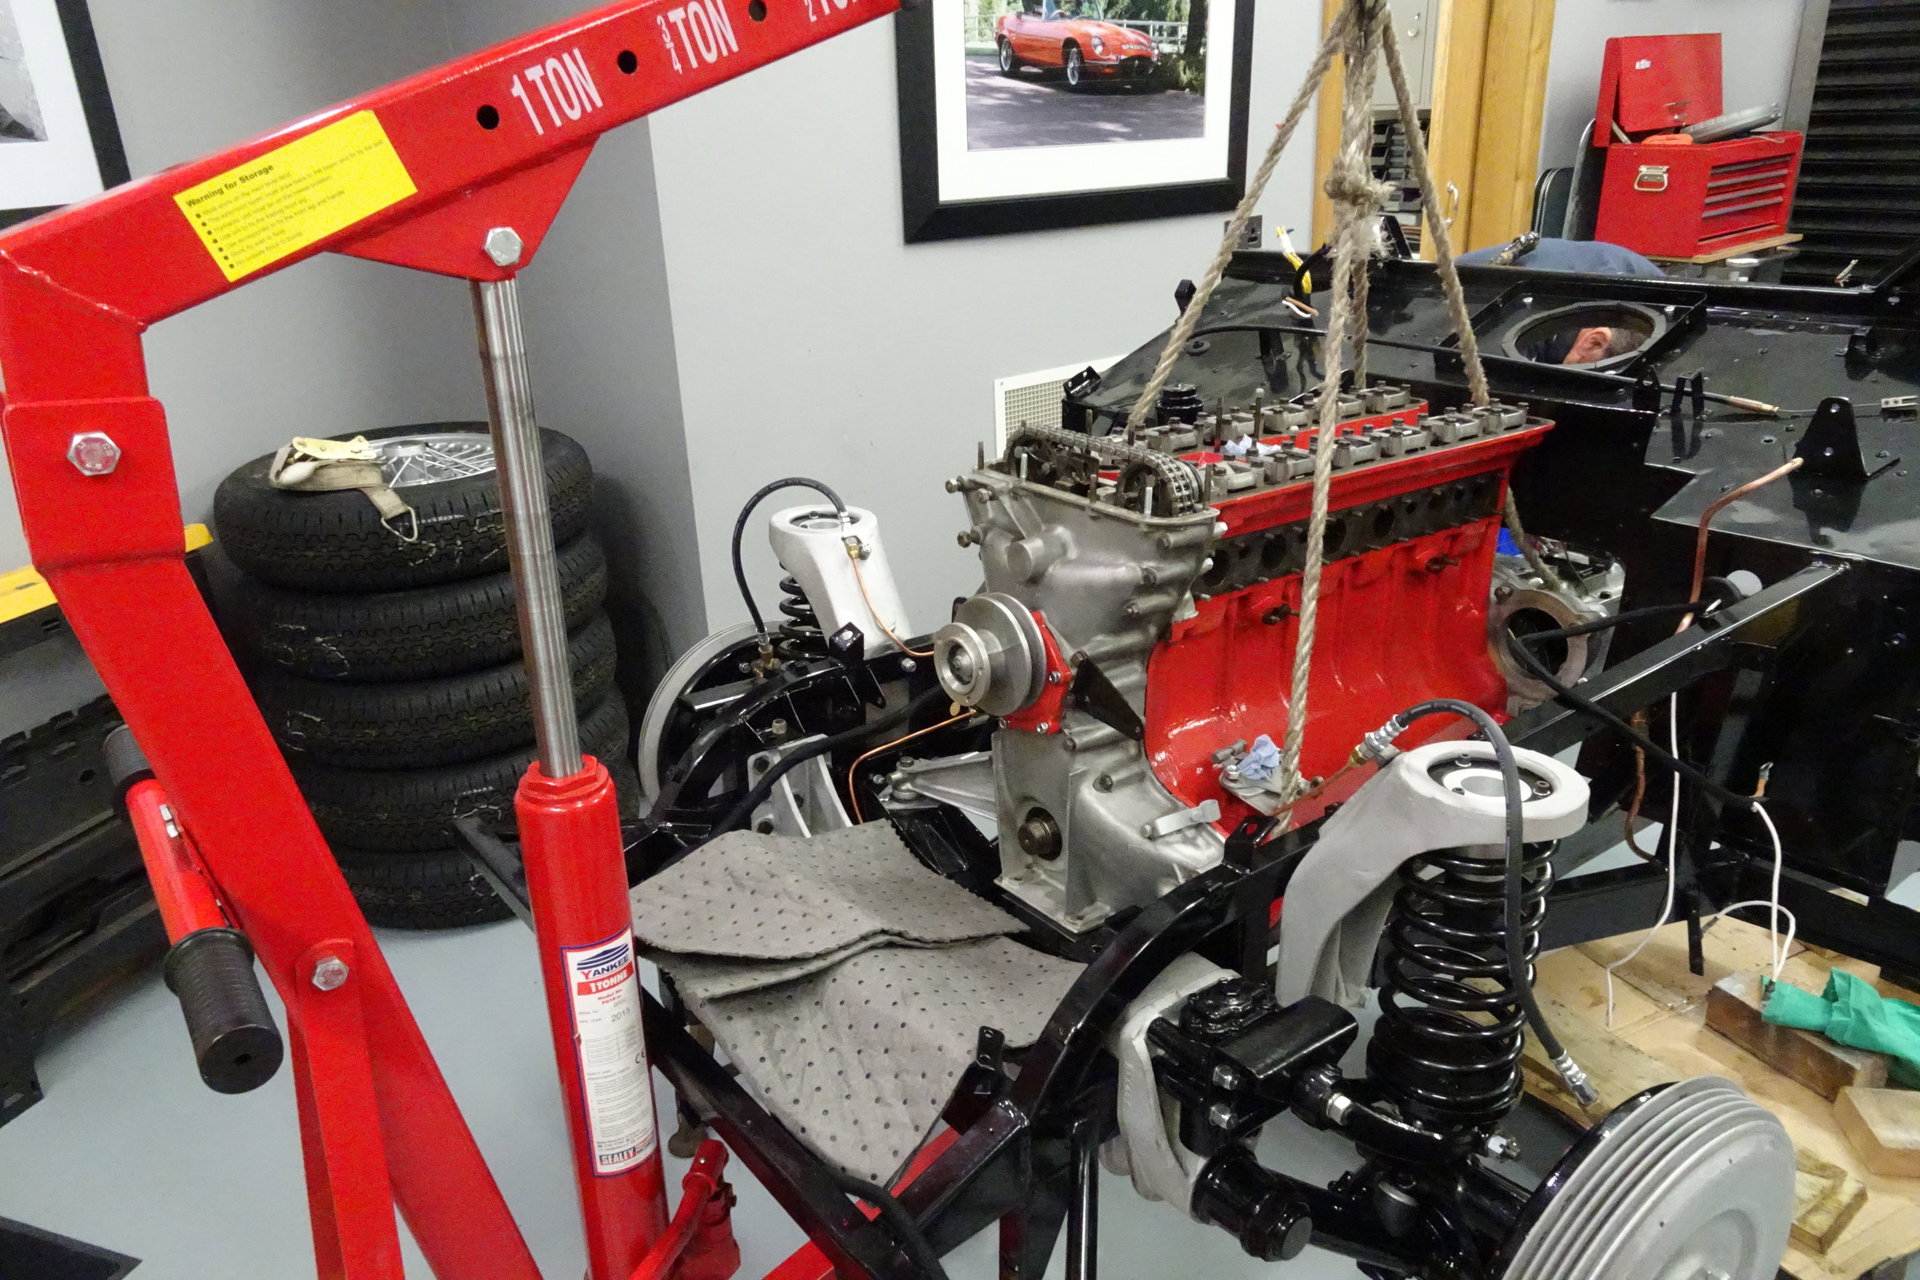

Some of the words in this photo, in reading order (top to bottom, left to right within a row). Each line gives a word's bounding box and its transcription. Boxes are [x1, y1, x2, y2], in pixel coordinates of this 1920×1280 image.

[667, 0, 739, 69] TON
[524, 47, 604, 128] TON
[186, 187, 225, 207] Warning
[224, 181, 237, 191] for
[239, 165, 274, 184] Storage
[581, 953, 629, 980] YANKEE
[611, 1006, 631, 1022] 2015
[600, 1147, 636, 1165] SEALEY
